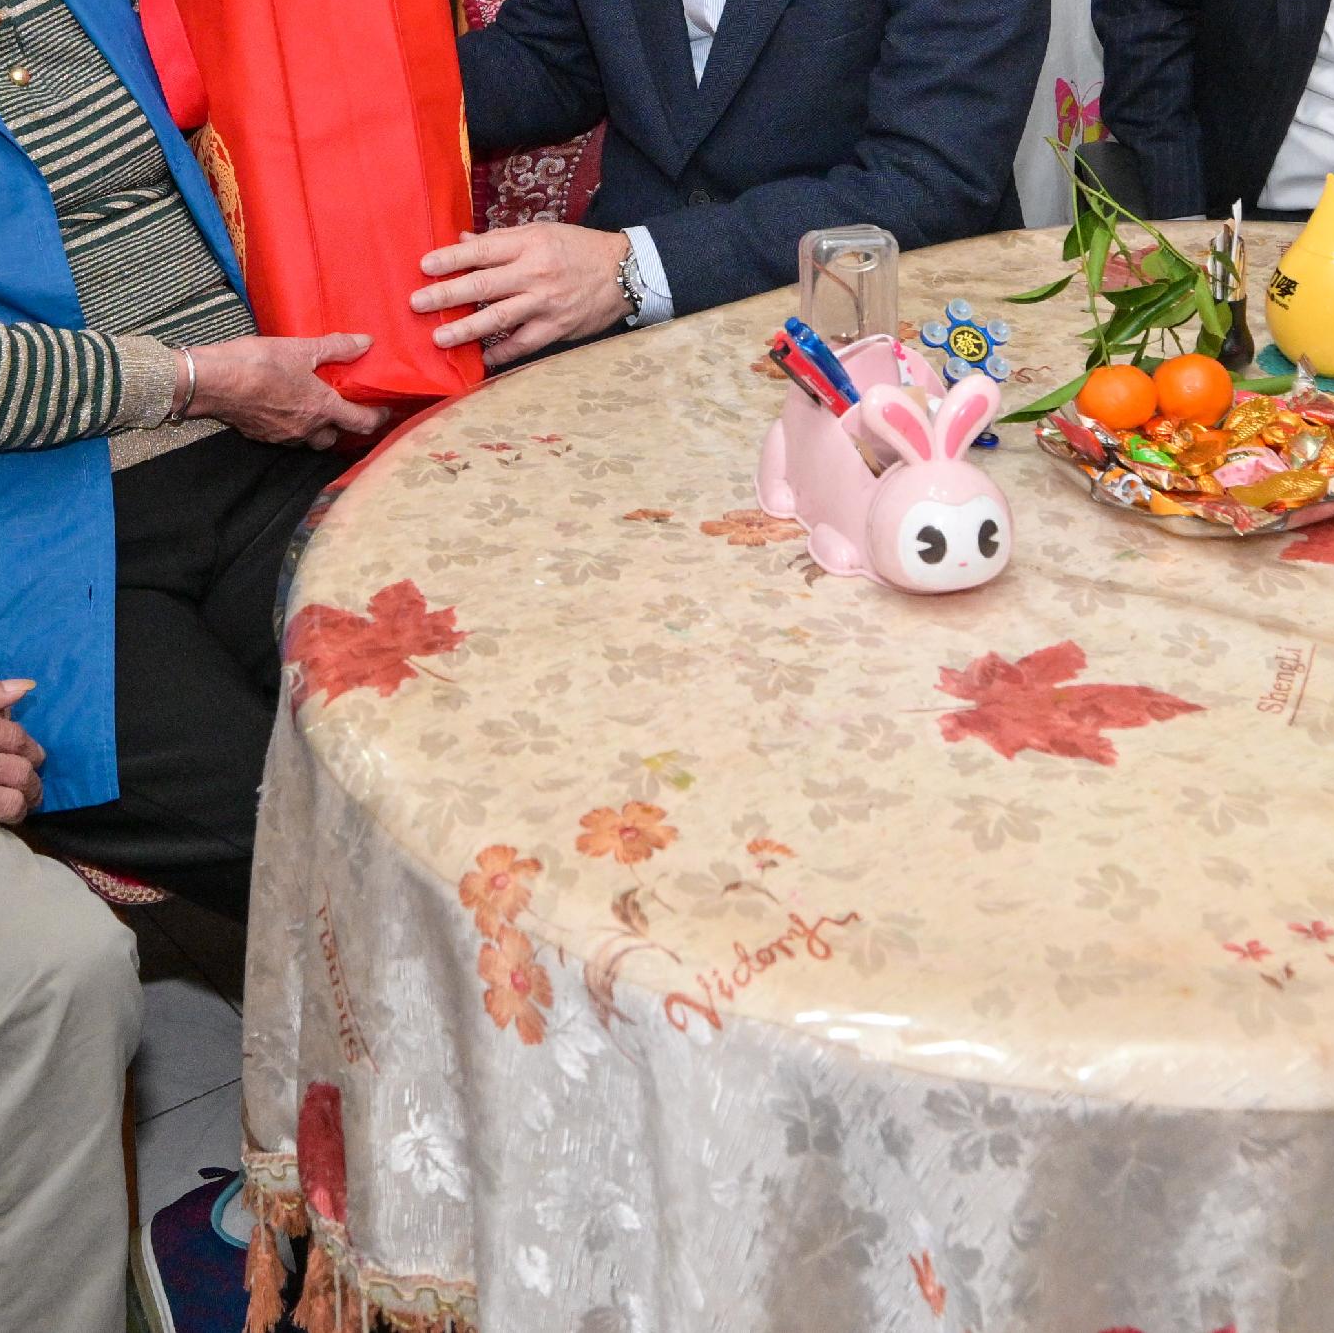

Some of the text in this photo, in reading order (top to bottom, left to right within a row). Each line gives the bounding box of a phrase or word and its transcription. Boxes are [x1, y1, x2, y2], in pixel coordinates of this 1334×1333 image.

[955, 332, 983, 355] 發
[1257, 646, 1305, 714] ShengLi
[664, 911, 862, 1032] Victory
